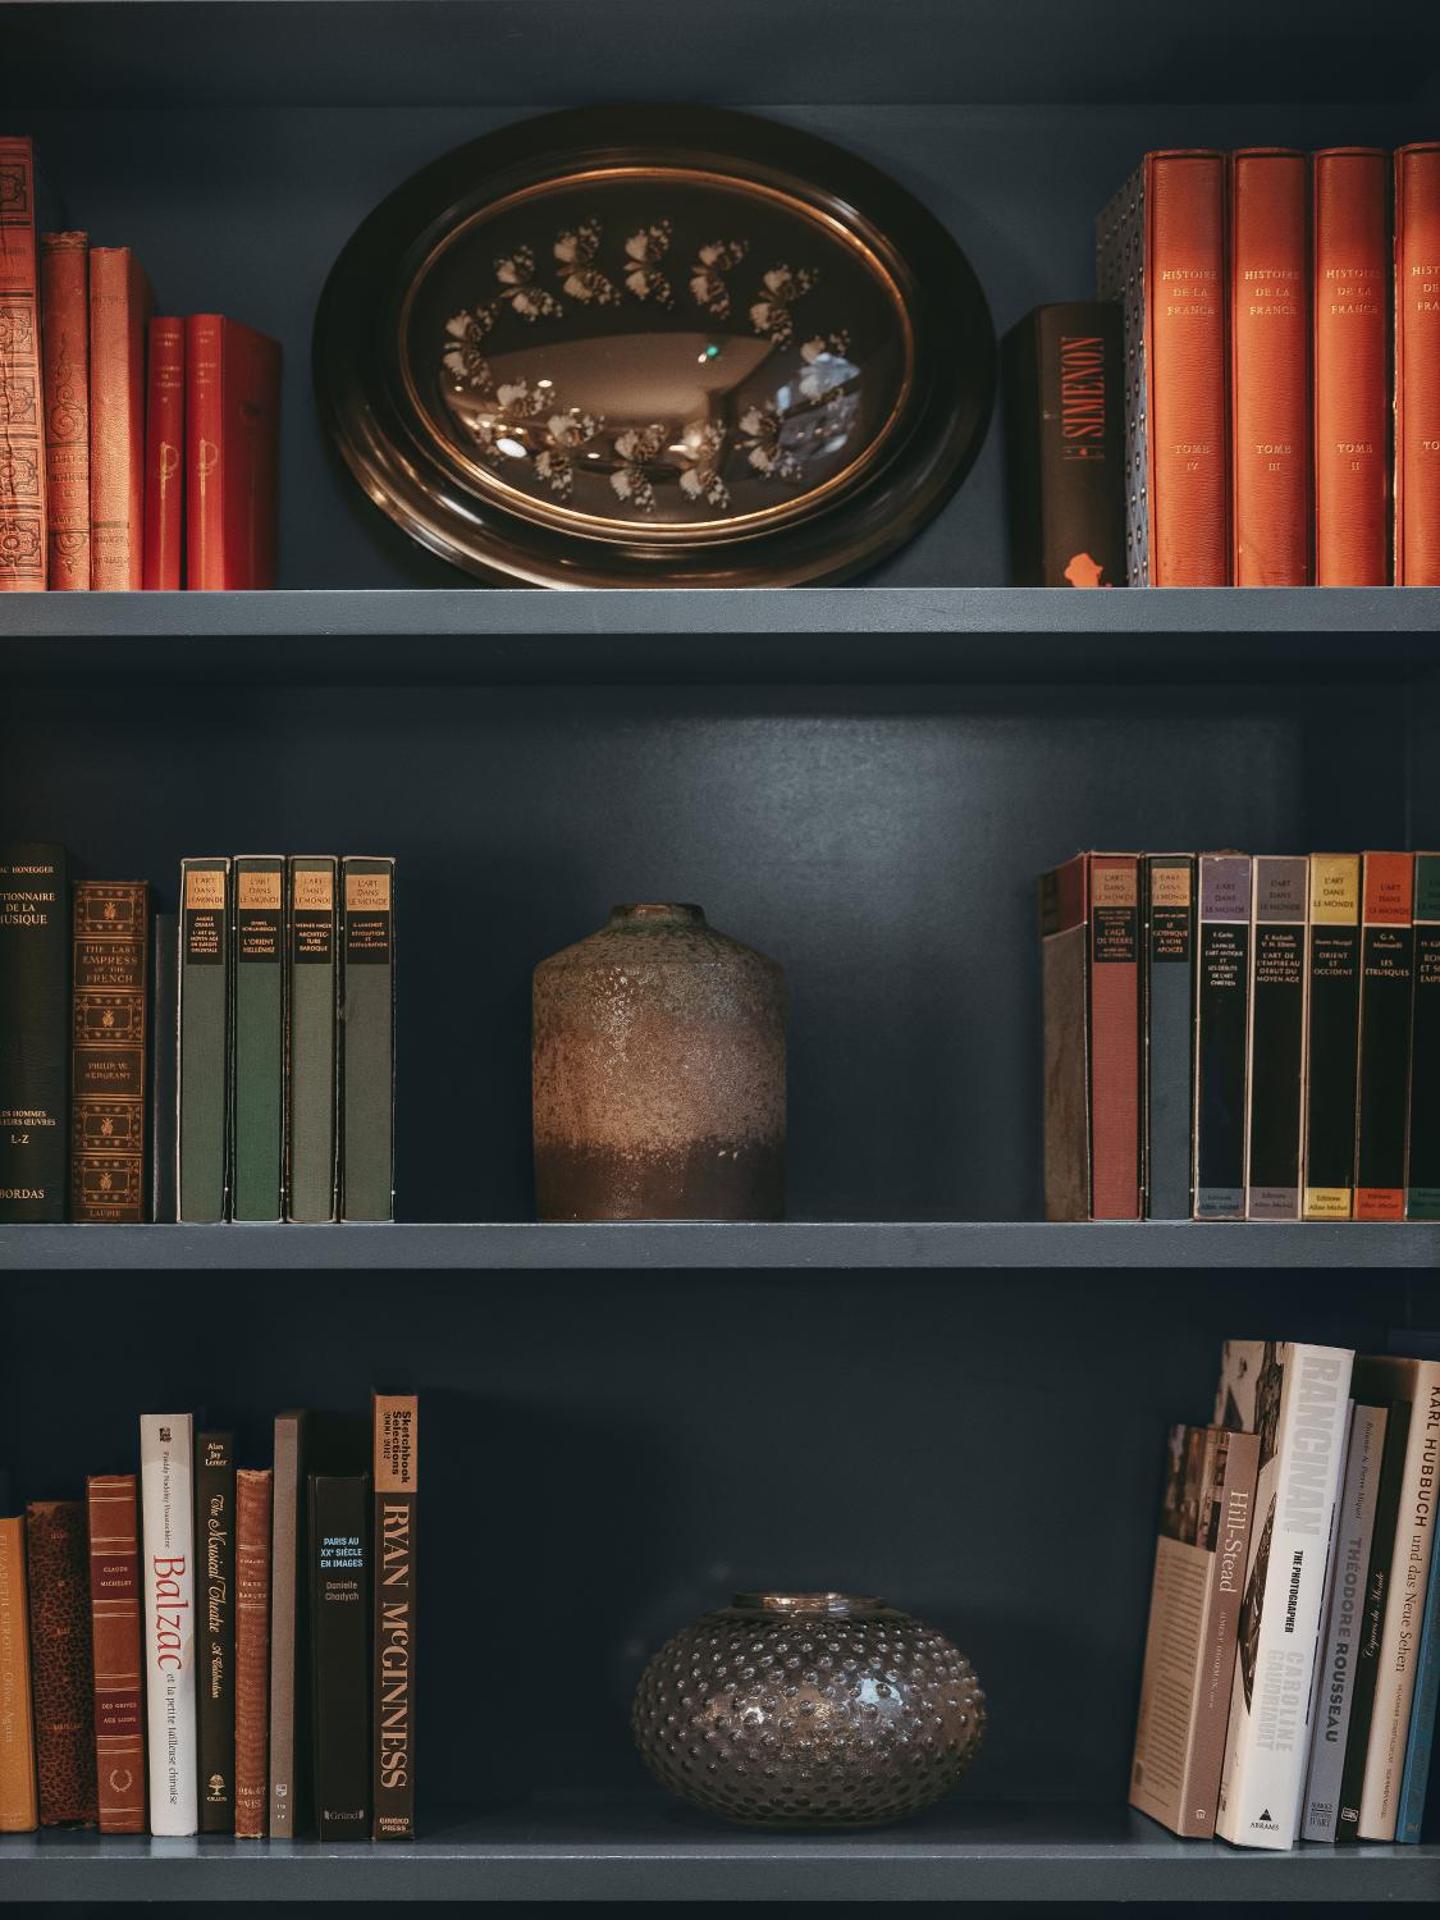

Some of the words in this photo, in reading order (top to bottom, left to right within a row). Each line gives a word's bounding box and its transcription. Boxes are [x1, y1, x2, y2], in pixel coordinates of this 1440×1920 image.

[1162, 270, 1217, 281] HISTOIRE
[1244, 270, 1299, 281] HISTOIRE
[1326, 268, 1381, 279] HISTOIRE
[1173, 287, 1191, 297] DE
[1193, 287, 1208, 297] LA
[1255, 287, 1273, 297] DE
[1276, 287, 1291, 297] LA
[1336, 287, 1354, 296] DE
[1358, 287, 1373, 296] LA
[1167, 305, 1215, 316] FRANCE
[1249, 305, 1297, 316] FRANCE
[1331, 304, 1378, 315] FRANCE
[1061, 337, 1105, 438] SIMENON
[1175, 444, 1210, 454] TOME
[1256, 444, 1292, 454] TOME
[1336, 443, 1373, 453] TOME
[11, 865, 55, 874] HONEGGER
[1324, 876, 1344, 884] L'ART
[1323, 888, 1345, 896] DANS
[6, 902, 20, 912] DE
[22, 902, 36, 912] LA
[243, 938, 274, 946] L'ORIENT
[82, 955, 139, 966] EMPRESS
[1262, 951, 1282, 959] L'ART
[1319, 951, 1348, 960] ORIENT
[1257, 959, 1288, 967] L'EMPIRE
[1288, 960, 1300, 968] AU
[1380, 959, 1393, 967] LES
[1286, 968, 1298, 976] DU
[1314, 968, 1353, 976] OCCIDENT
[86, 974, 134, 985] FRENCH
[11, 1134, 30, 1144] L-Z
[1427, 1387, 1440, 1430] KARL
[392, 1411, 402, 1475] Selections
[401, 1411, 411, 1483] Sketchbook
[1285, 1357, 1340, 1535] RANCINAN
[1414, 1438, 1437, 1527] HUBBUCH
[211, 1494, 224, 1516] The
[323, 1537, 347, 1546] PARIS
[348, 1537, 360, 1546] AU
[383, 1502, 409, 1588] RYAN
[1219, 1490, 1248, 1592] Hill-Stead
[208, 1519, 227, 1580] Musical
[335, 1546, 363, 1556] SIÈCLE
[1410, 1535, 1423, 1562] und
[320, 1559, 331, 1568] EN
[332, 1559, 363, 1568] IMAGES
[1293, 1550, 1304, 1566] THE
[1406, 1565, 1421, 1589] das
[326, 1580, 358, 1590] Danielle
[1339, 1537, 1361, 1638] THÉODORE
[1285, 1566, 1301, 1633] PHOTOGRAPHER
[153, 1555, 189, 1670] Balzac
[209, 1581, 226, 1634] Theatre
[1401, 1592, 1417, 1627] Neue
[1396, 1631, 1413, 1673] Sehen
[167, 1674, 175, 1683] et
[1326, 1642, 1349, 1743] ROUSSEAU
[1276, 1651, 1304, 1752] CAROLINE
[165, 1698, 176, 1724] petite
[168, 1727, 178, 1766] tailleuse
[169, 1767, 179, 1805] chinoise
[1250, 1821, 1280, 1831] ABRAMS
